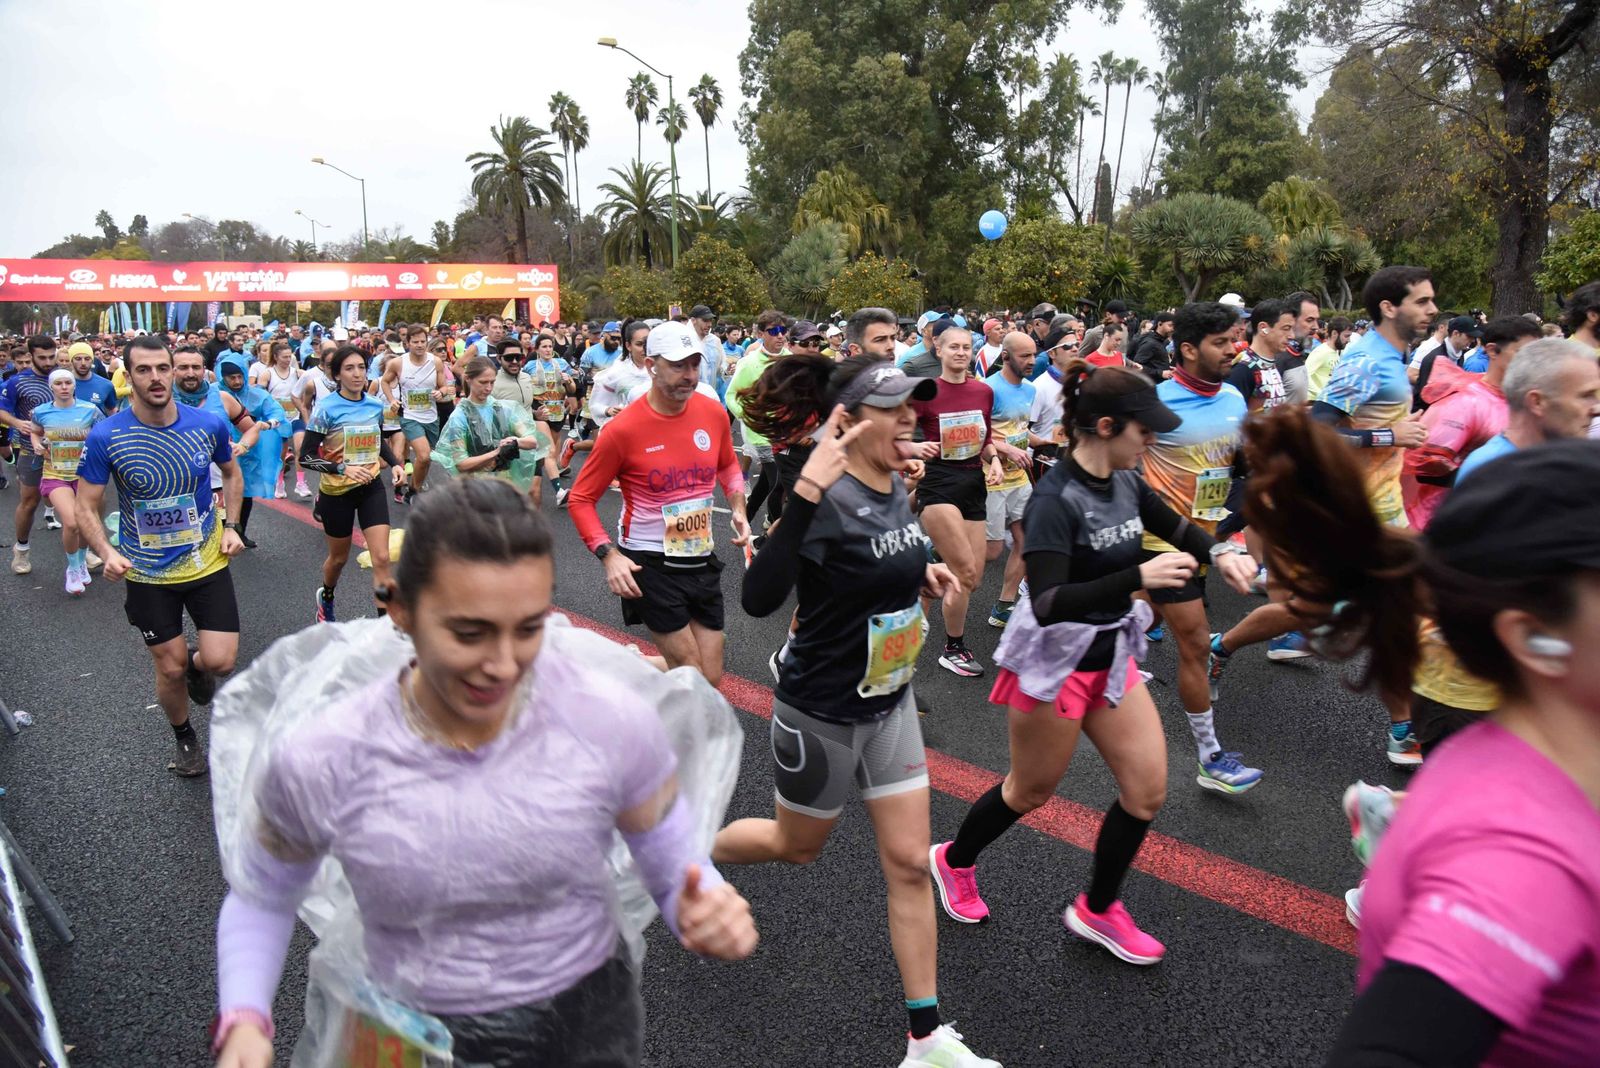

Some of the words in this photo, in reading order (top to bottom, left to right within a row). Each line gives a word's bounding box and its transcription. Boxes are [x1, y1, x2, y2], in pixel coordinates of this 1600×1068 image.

[109, 273, 159, 289] HOKA
[351, 274, 391, 288] HOKA
[949, 426, 978, 440] 4208
[144, 509, 184, 527] 3232
[676, 512, 707, 532] 6009
